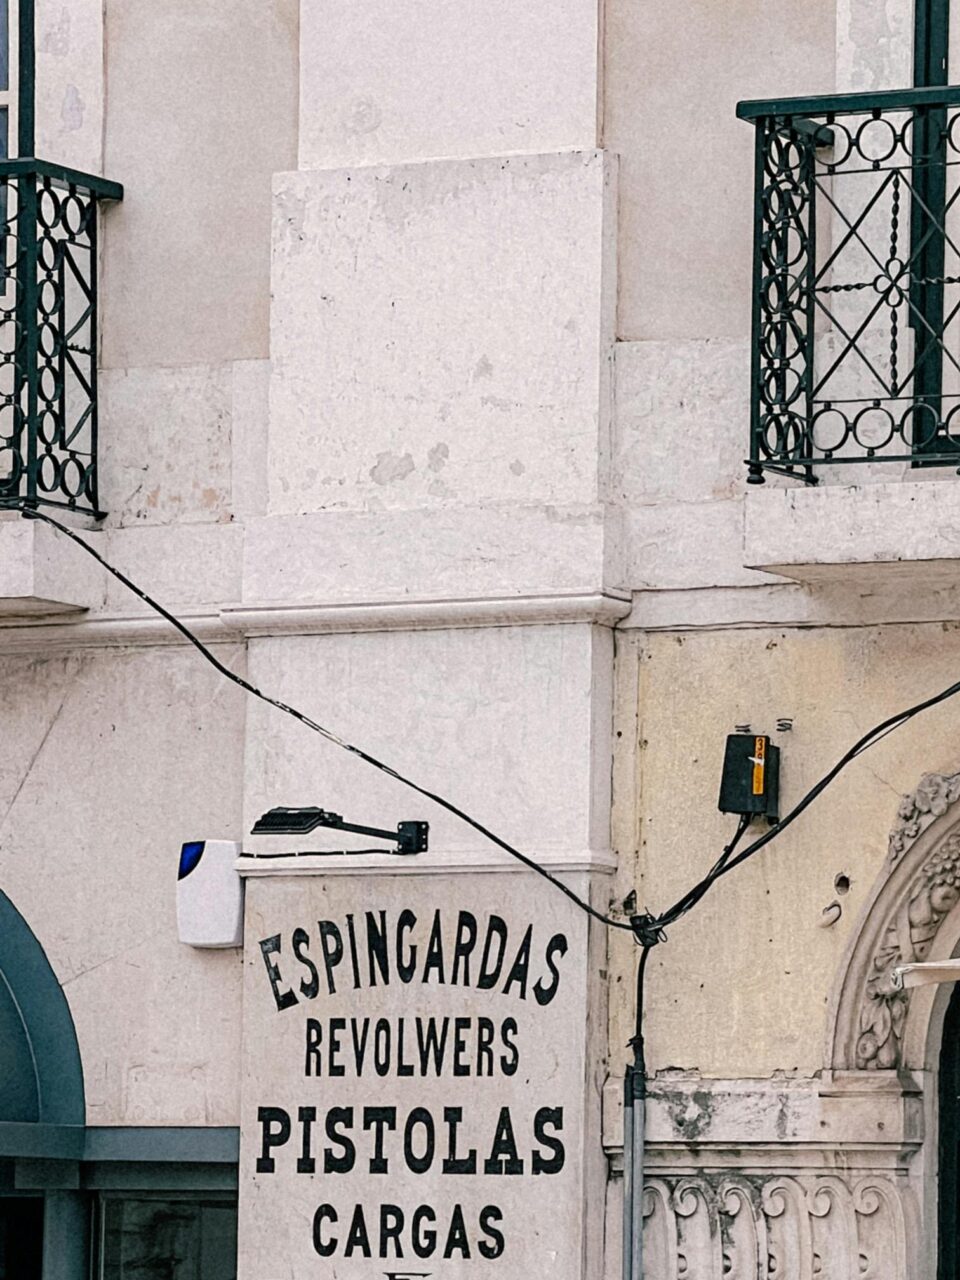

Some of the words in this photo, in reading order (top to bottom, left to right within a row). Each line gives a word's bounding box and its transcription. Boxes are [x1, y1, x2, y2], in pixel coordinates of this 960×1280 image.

[258, 908, 568, 1012] ESPINGARDAS
[305, 1017, 519, 1077] REVOLWERS
[256, 1106, 565, 1175] PISTOLAS
[312, 1203, 505, 1259] CARGAS
